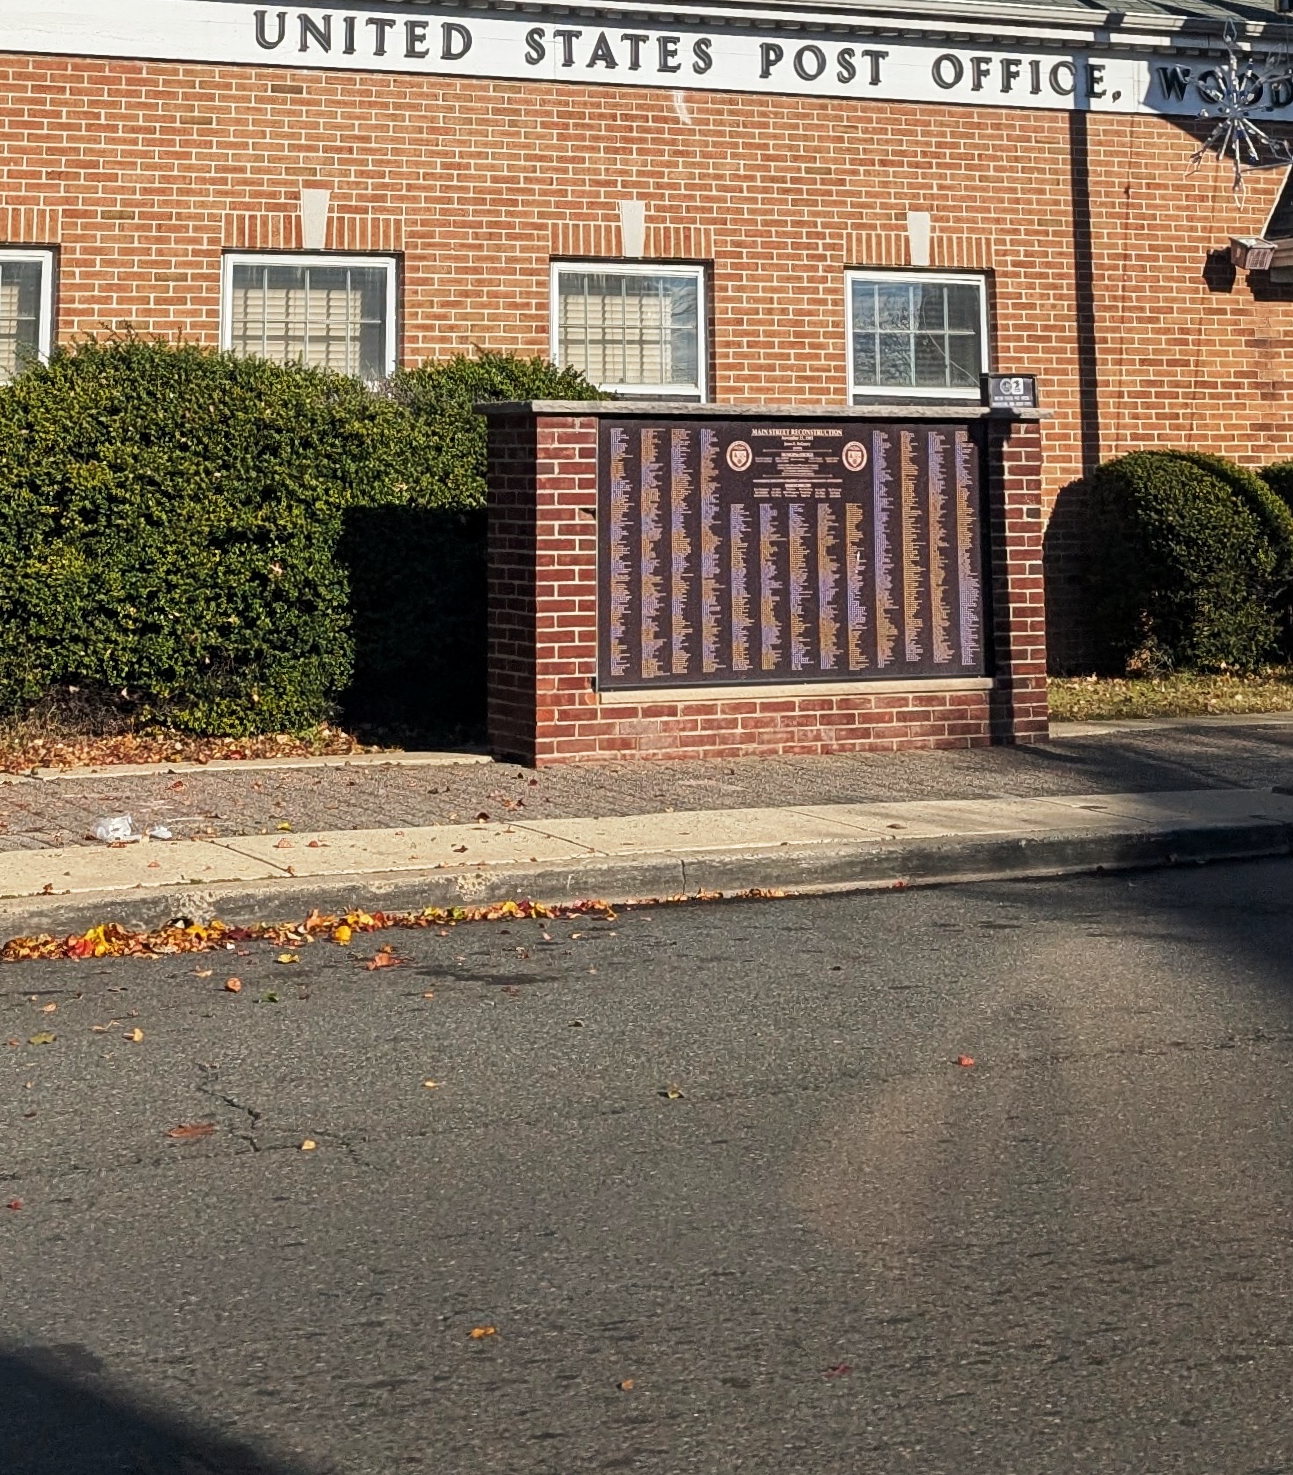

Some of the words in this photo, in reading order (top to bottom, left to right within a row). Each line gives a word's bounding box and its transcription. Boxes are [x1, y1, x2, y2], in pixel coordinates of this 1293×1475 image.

[253, 9, 473, 61] UNITED
[524, 26, 714, 75] STATES
[758, 41, 890, 86] POST
[931, 52, 1122, 103] OFFICE,
[751, 428, 768, 436] MAIN
[769, 428, 790, 436] STREET
[791, 428, 843, 436] RECONSTRUCTION
